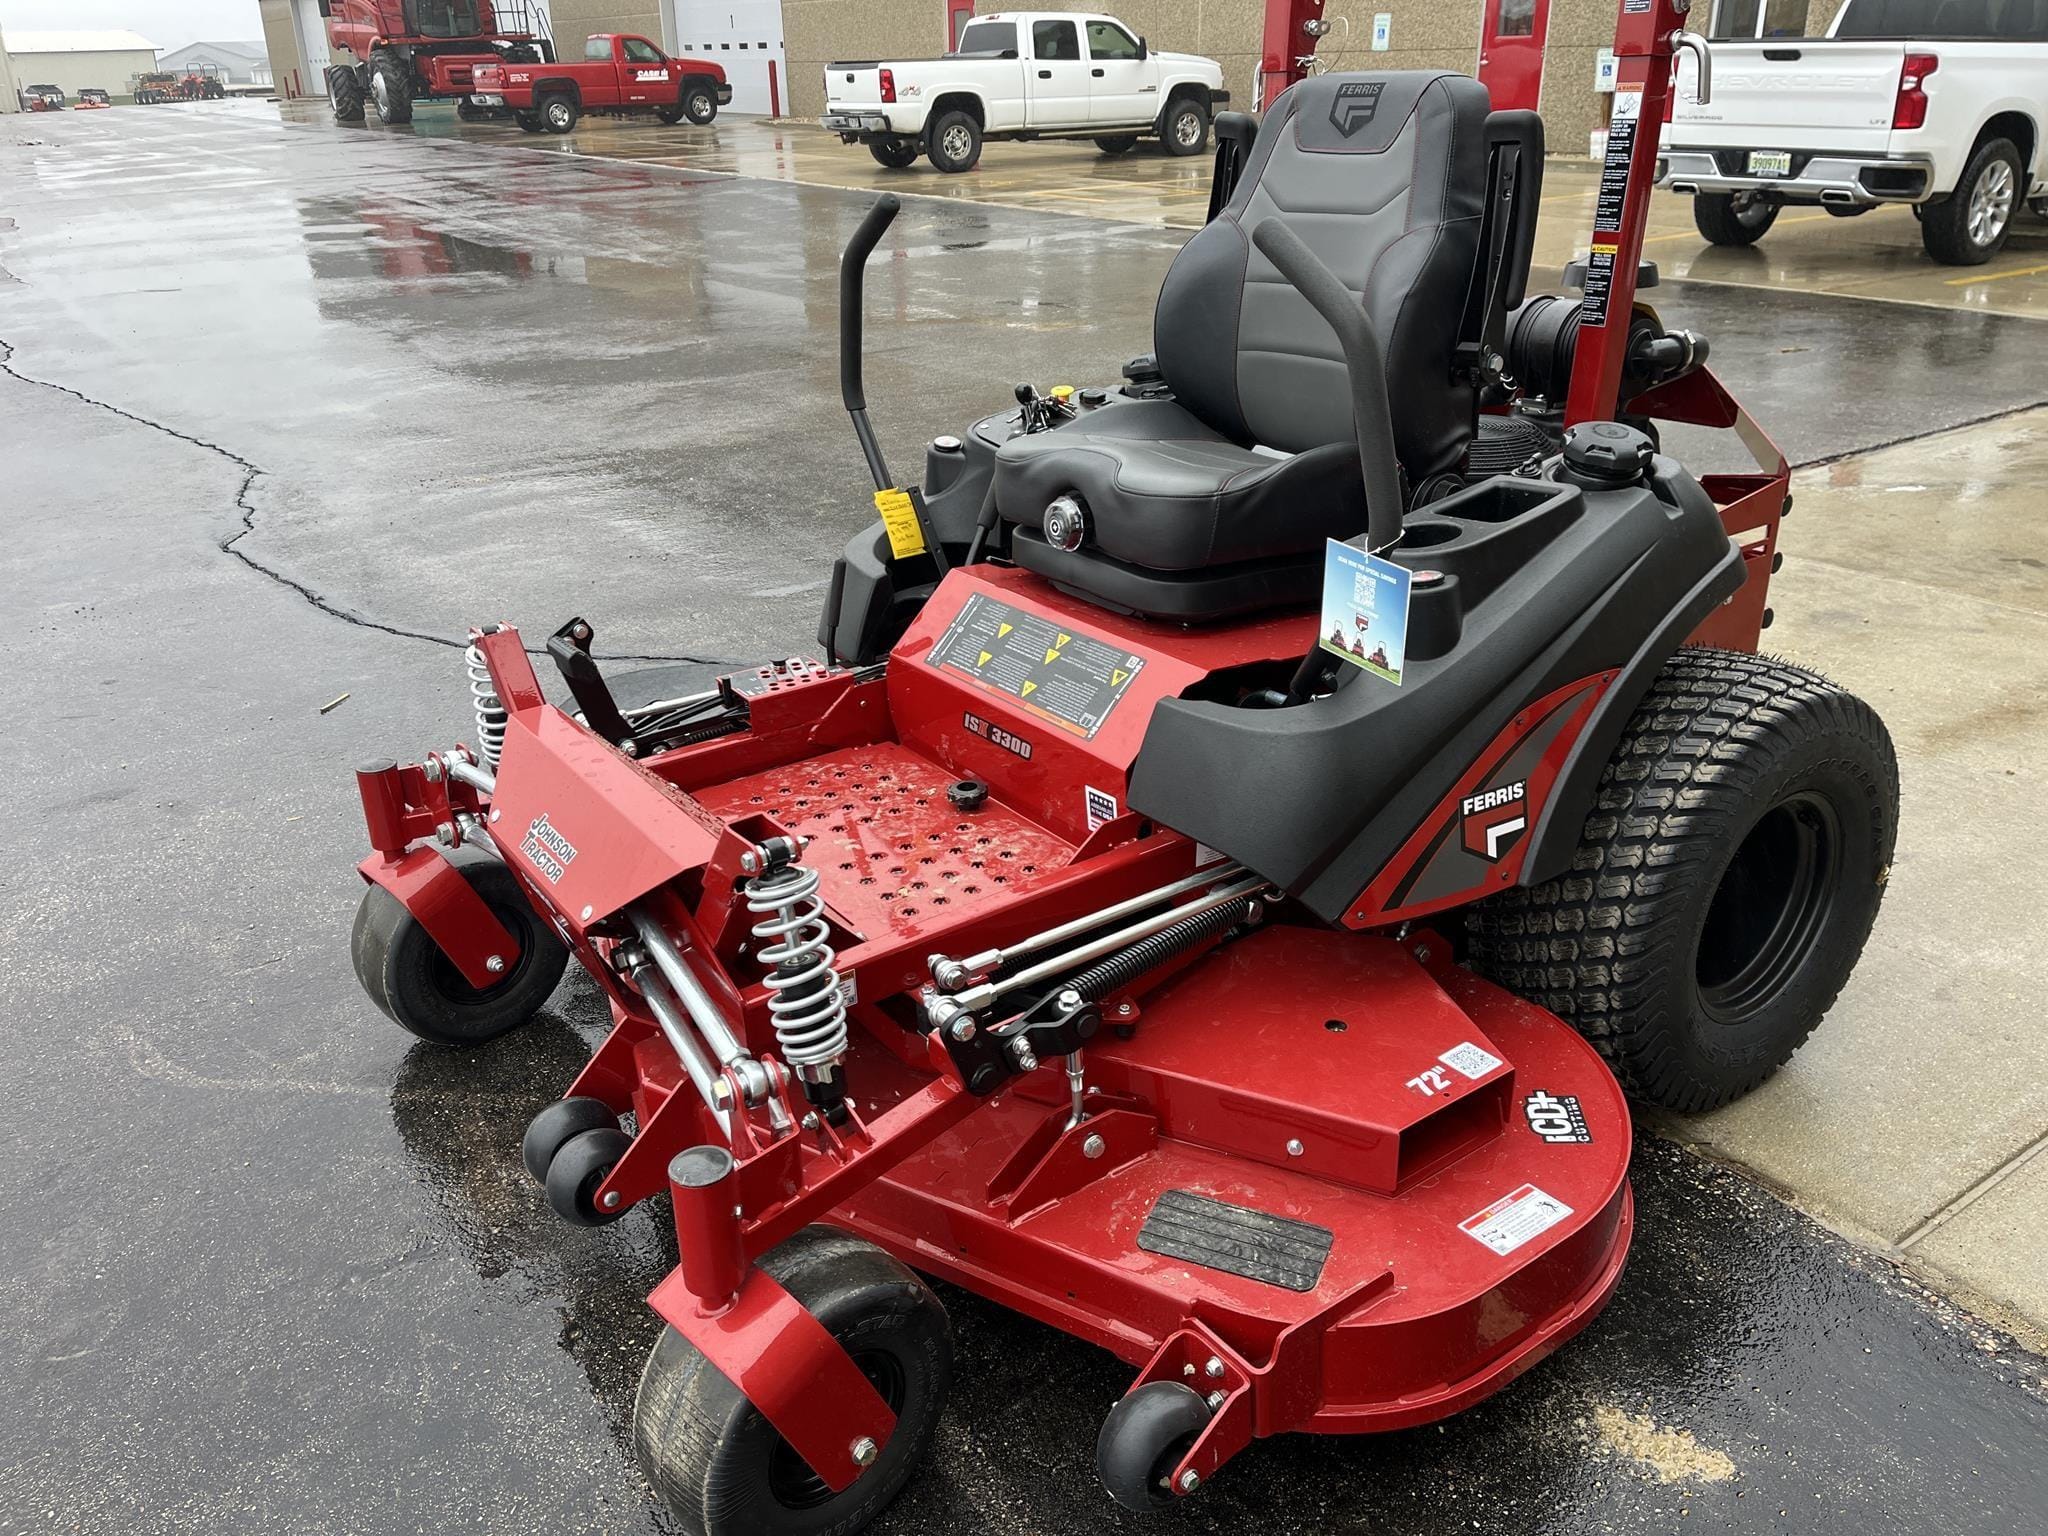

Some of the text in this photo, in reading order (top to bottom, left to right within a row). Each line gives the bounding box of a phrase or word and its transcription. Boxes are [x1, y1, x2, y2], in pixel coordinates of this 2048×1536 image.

[1340, 84, 1381, 95] FERRIS
[964, 712, 1032, 759] ISX 3300
[1463, 781, 1526, 816] FERRIS
[520, 829, 564, 884] TRACTOR
[531, 813, 577, 864] JOHNSON
[1405, 1065, 1452, 1097] 72"
[1564, 1096, 1591, 1143] CUTTING
